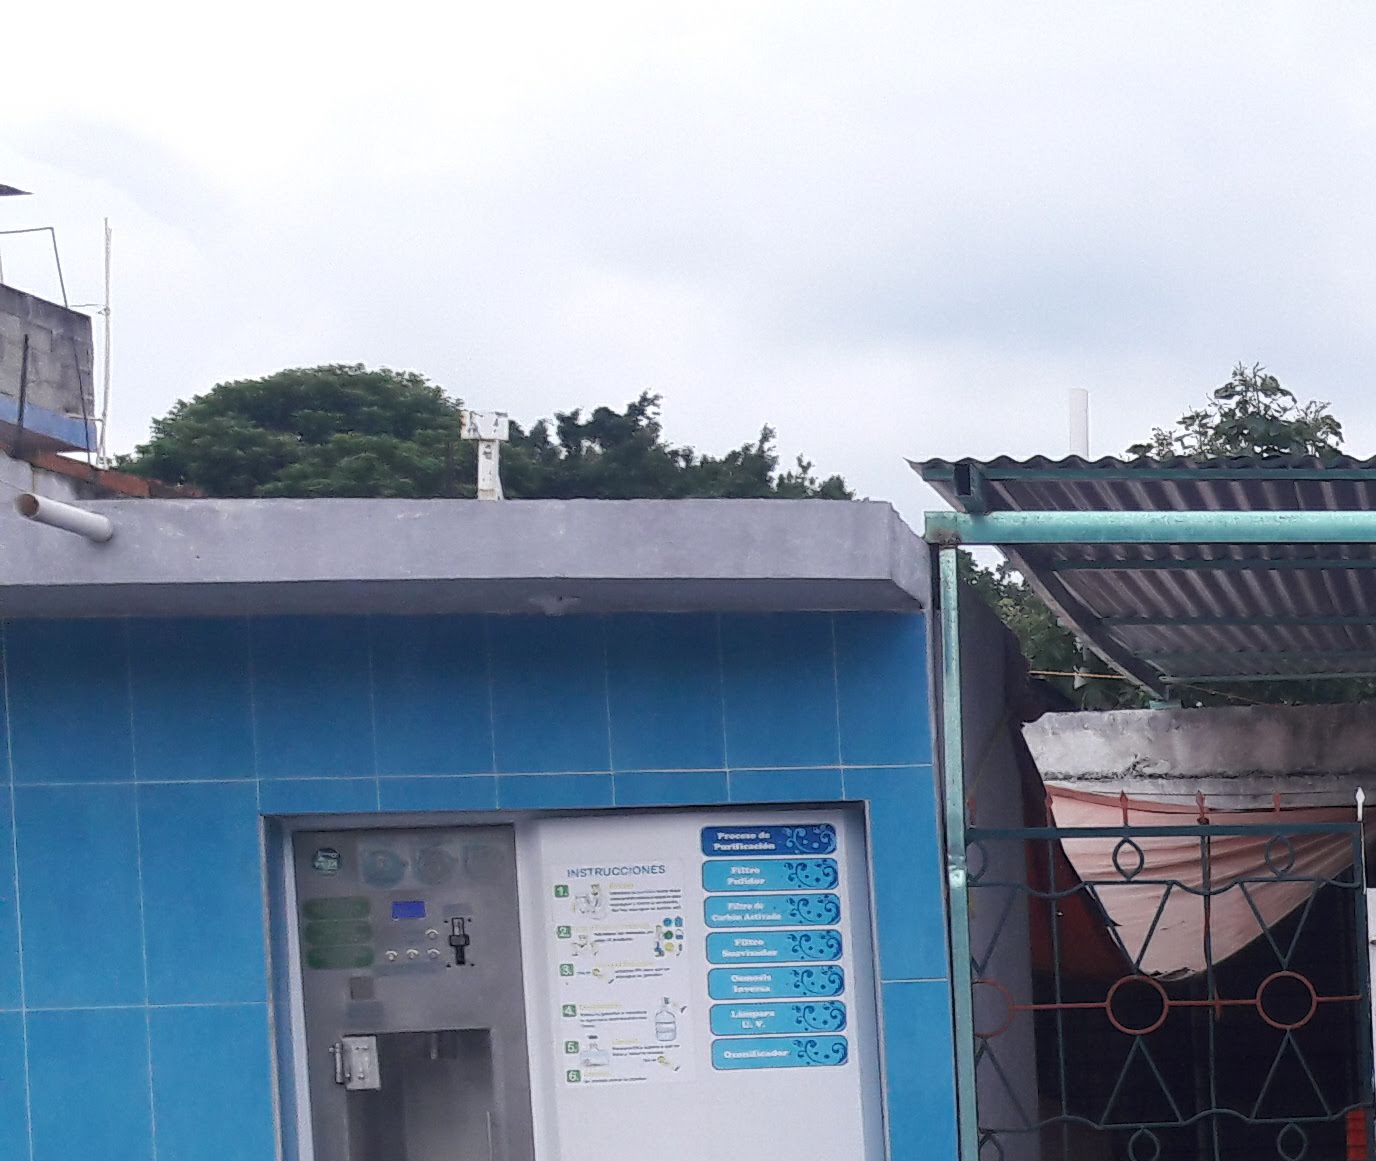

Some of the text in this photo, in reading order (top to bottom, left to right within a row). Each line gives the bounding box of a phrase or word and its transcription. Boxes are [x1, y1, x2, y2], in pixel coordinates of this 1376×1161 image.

[717, 831, 771, 841] Proceso de
[713, 842, 776, 851] Purificación
[567, 865, 666, 878] INSTRUCCIONES
[731, 866, 761, 875] Filtro
[728, 902, 764, 911] Filtro de
[743, 913, 782, 921] Activado
[734, 938, 764, 947] Filtro
[722, 949, 779, 958] Suavizador
[733, 985, 771, 993] Inversa
[724, 1050, 790, 1059] Ozonificador
